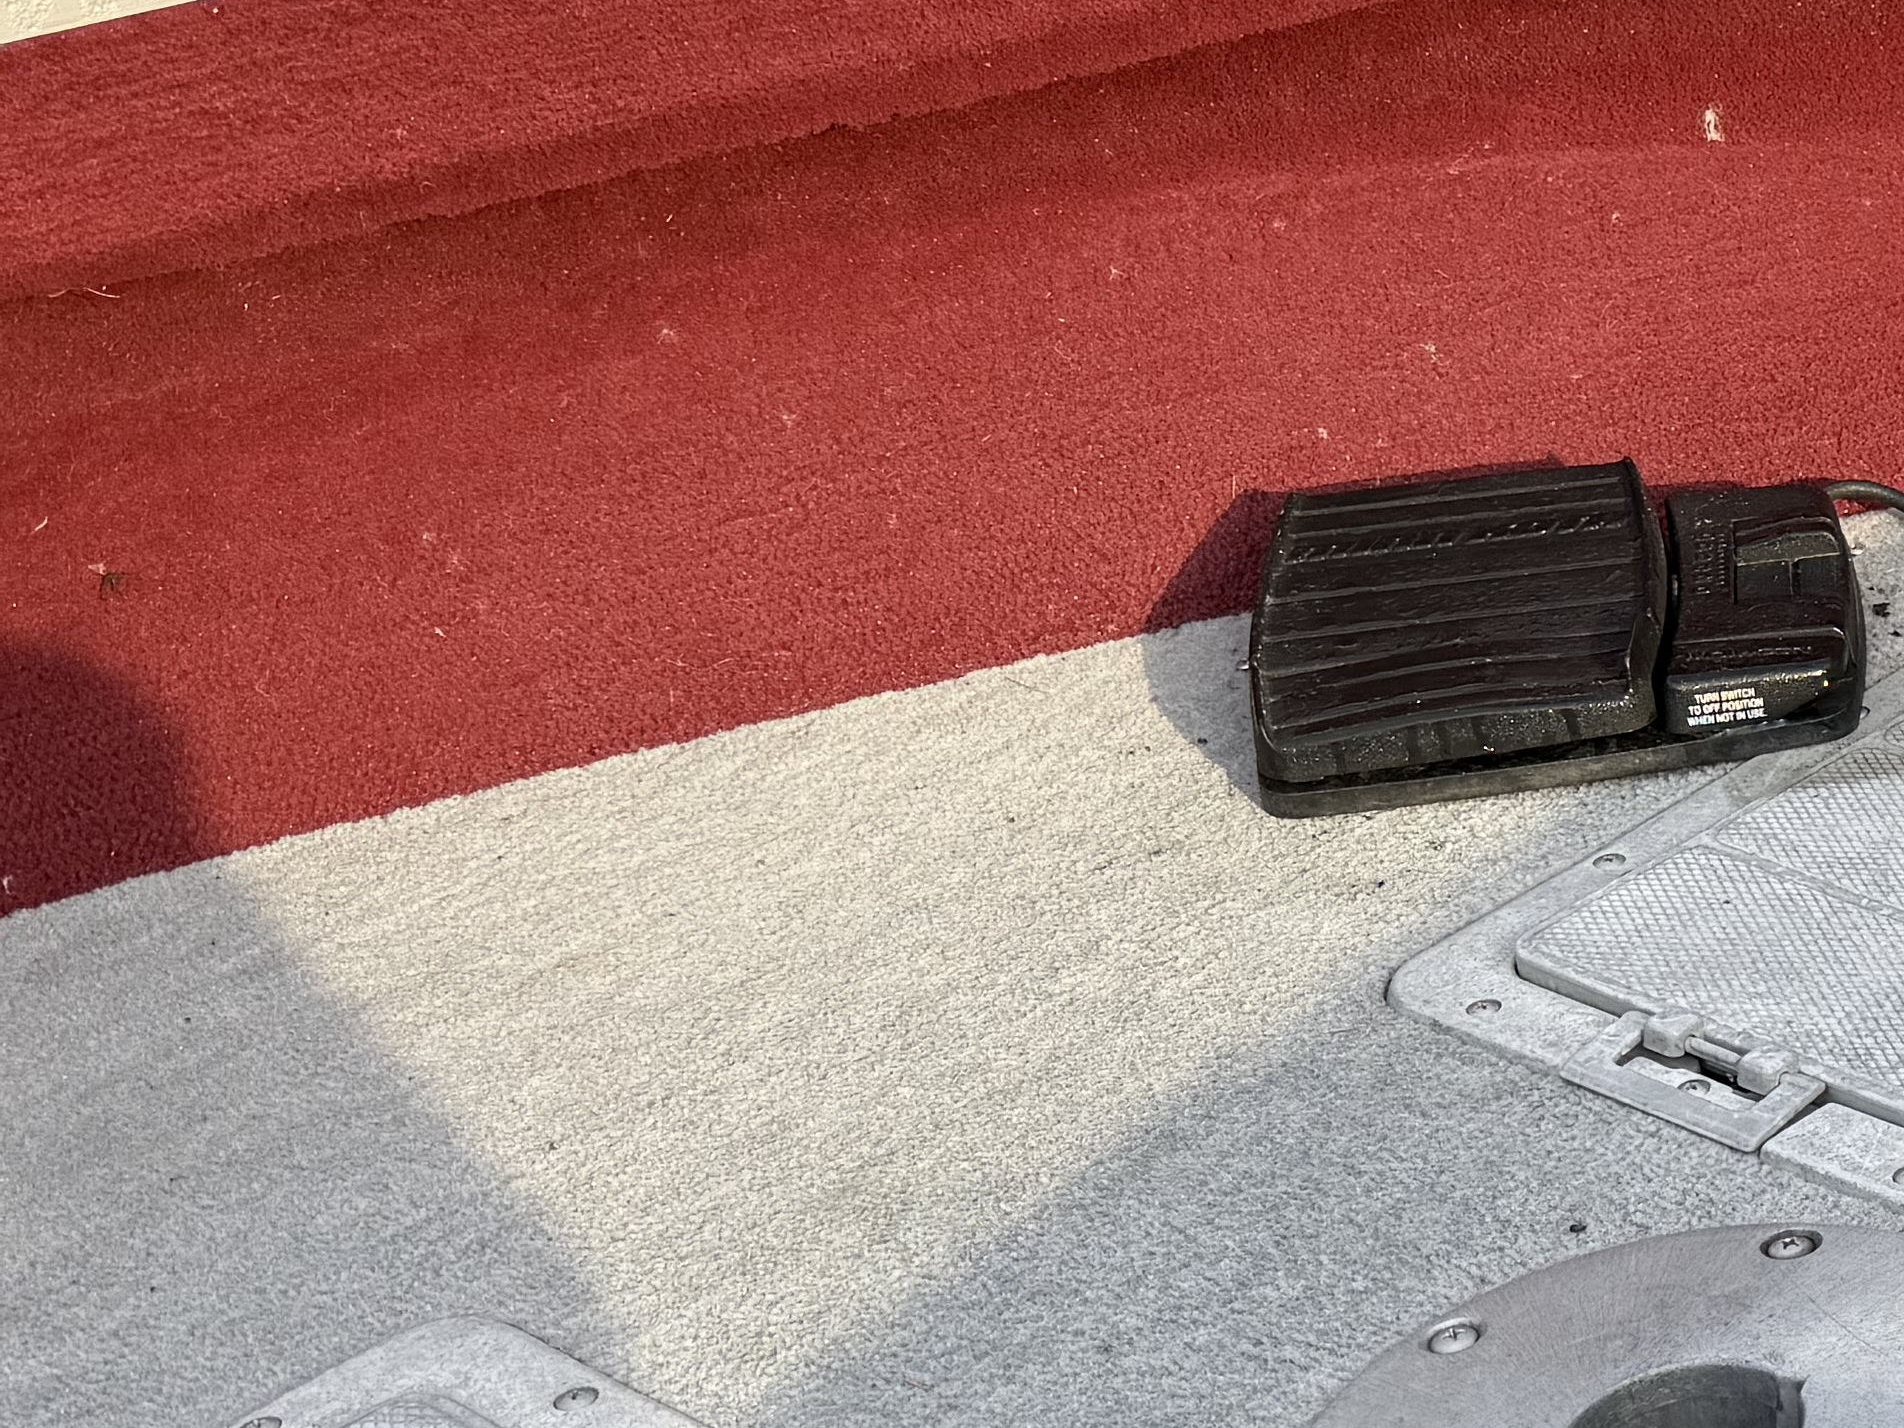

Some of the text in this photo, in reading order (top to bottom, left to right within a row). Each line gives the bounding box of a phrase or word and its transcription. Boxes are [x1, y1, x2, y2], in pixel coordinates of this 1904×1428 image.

[1694, 687, 1756, 704] TURN SWITCH
[1688, 697, 1764, 716] TO OFF POSITION
[1686, 715, 1715, 727] WHEN
[1715, 712, 1735, 723] NOT
[1735, 710, 1746, 721] IN
